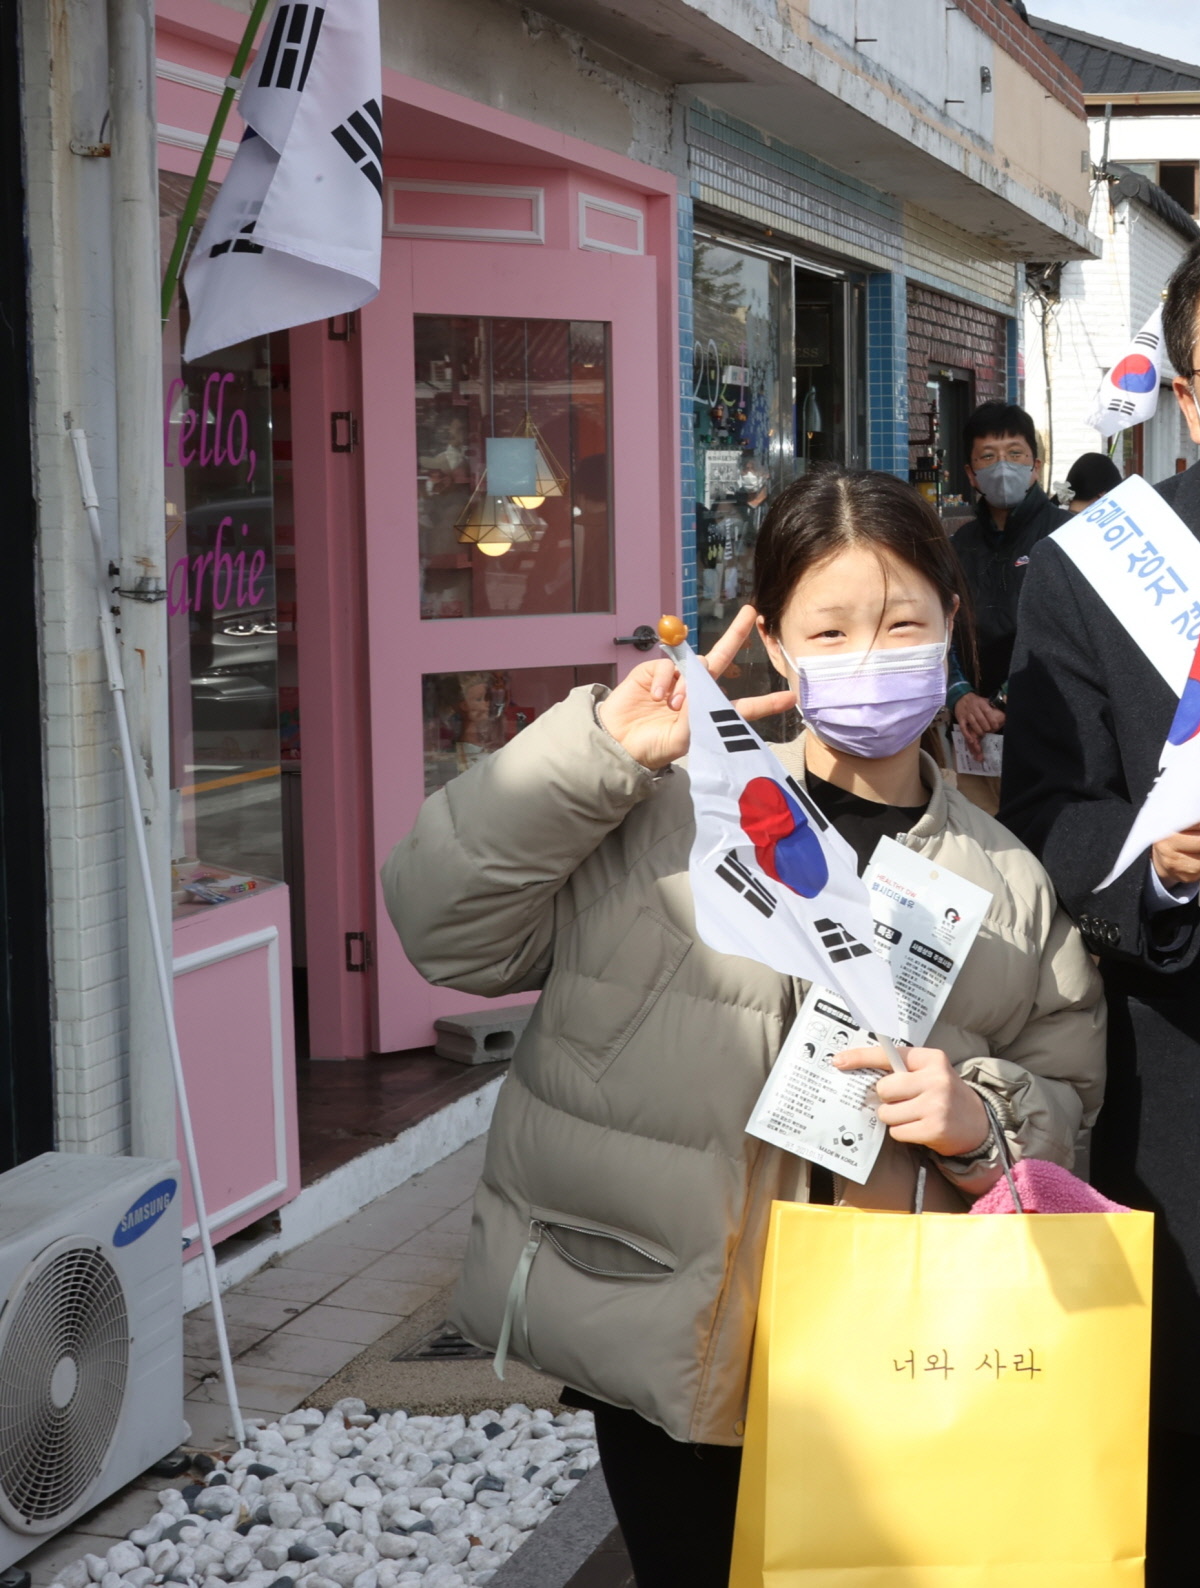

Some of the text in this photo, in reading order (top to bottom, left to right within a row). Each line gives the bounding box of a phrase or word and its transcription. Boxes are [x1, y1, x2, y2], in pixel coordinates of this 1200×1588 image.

[1127, 540, 1189, 607] 성지
[840, 1155, 859, 1168] KOREA
[121, 1193, 170, 1232] SAMSUNG
[893, 1349, 955, 1381] 너와
